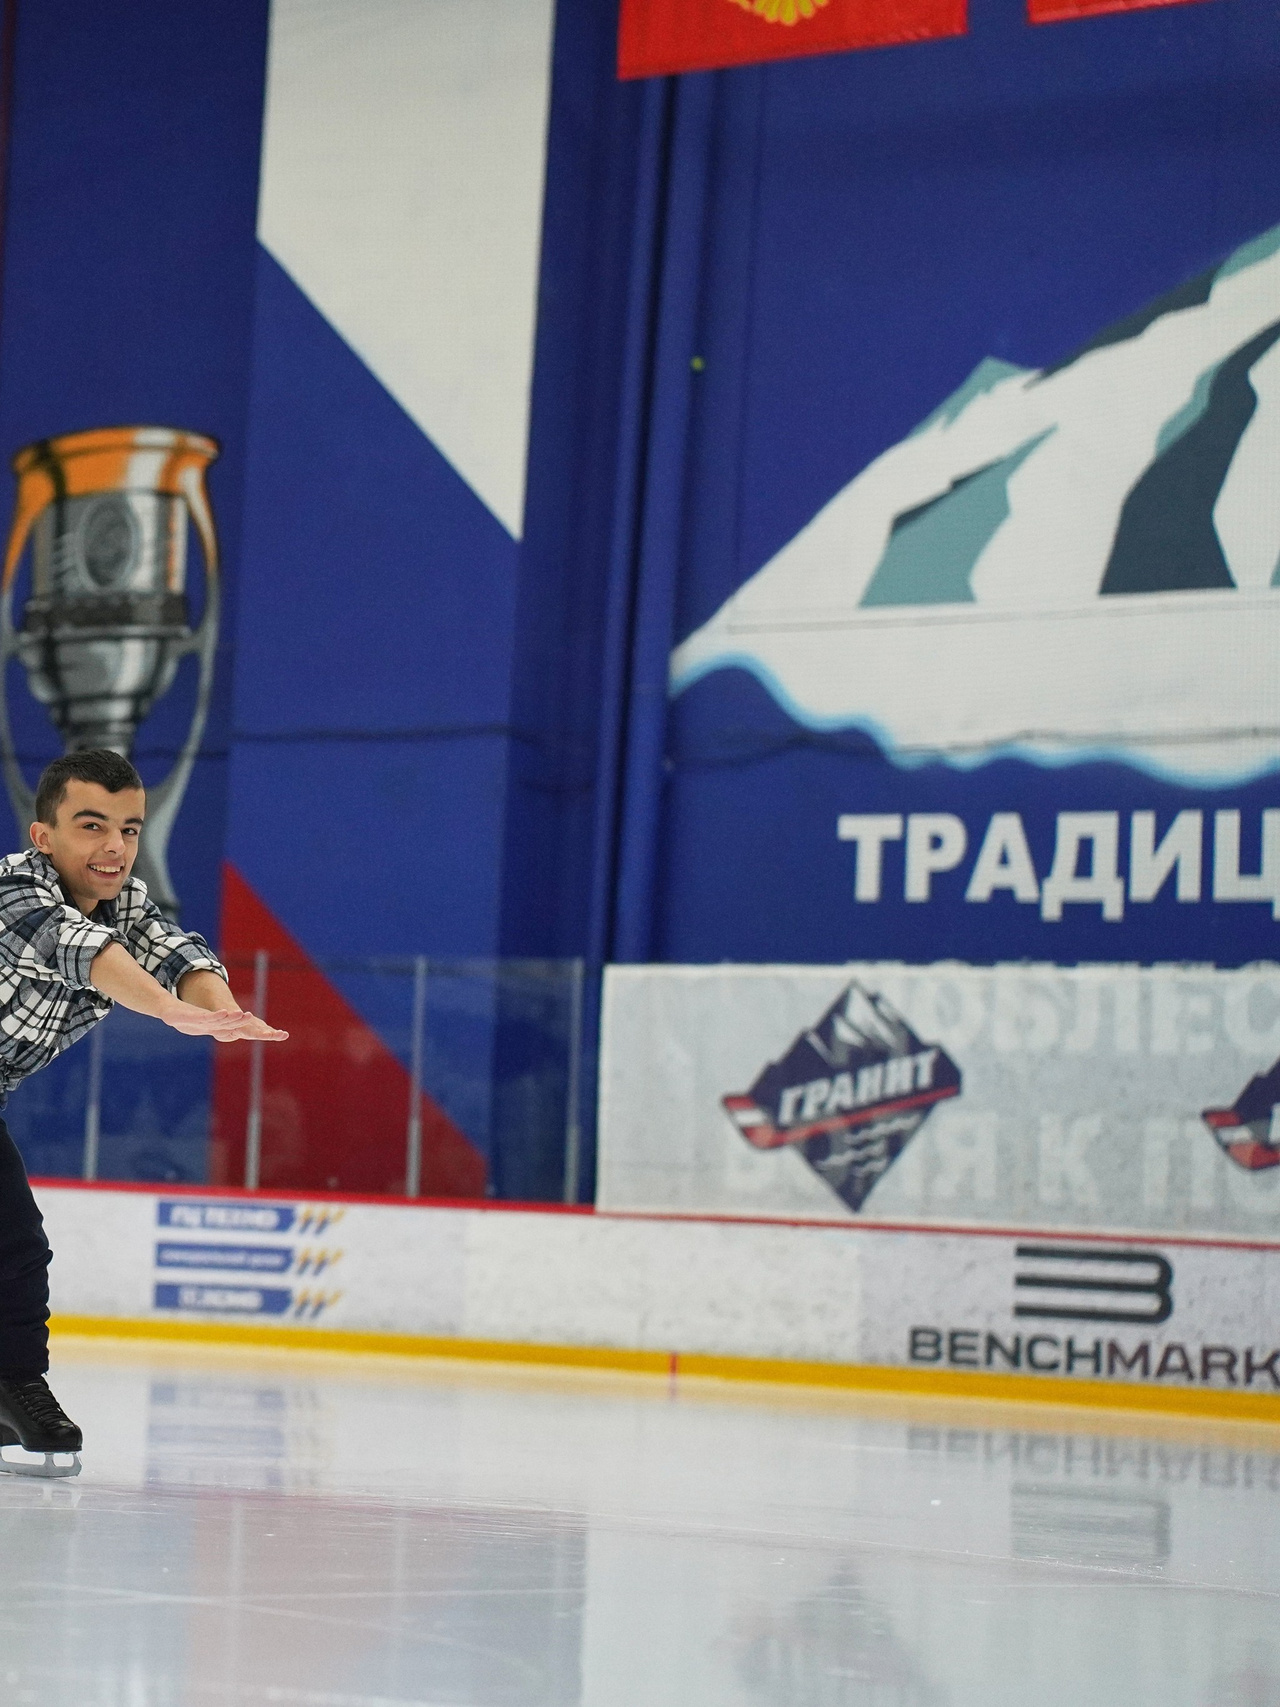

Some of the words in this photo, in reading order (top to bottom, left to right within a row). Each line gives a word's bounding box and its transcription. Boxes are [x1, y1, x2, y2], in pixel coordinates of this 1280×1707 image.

[837, 809, 1280, 921] ТРАДИЦ
[848, 962, 1280, 1054] ОБЛЕС
[777, 1050, 940, 1126] ГРАНИТ
[908, 1326, 1280, 1389] BENCHMARK
